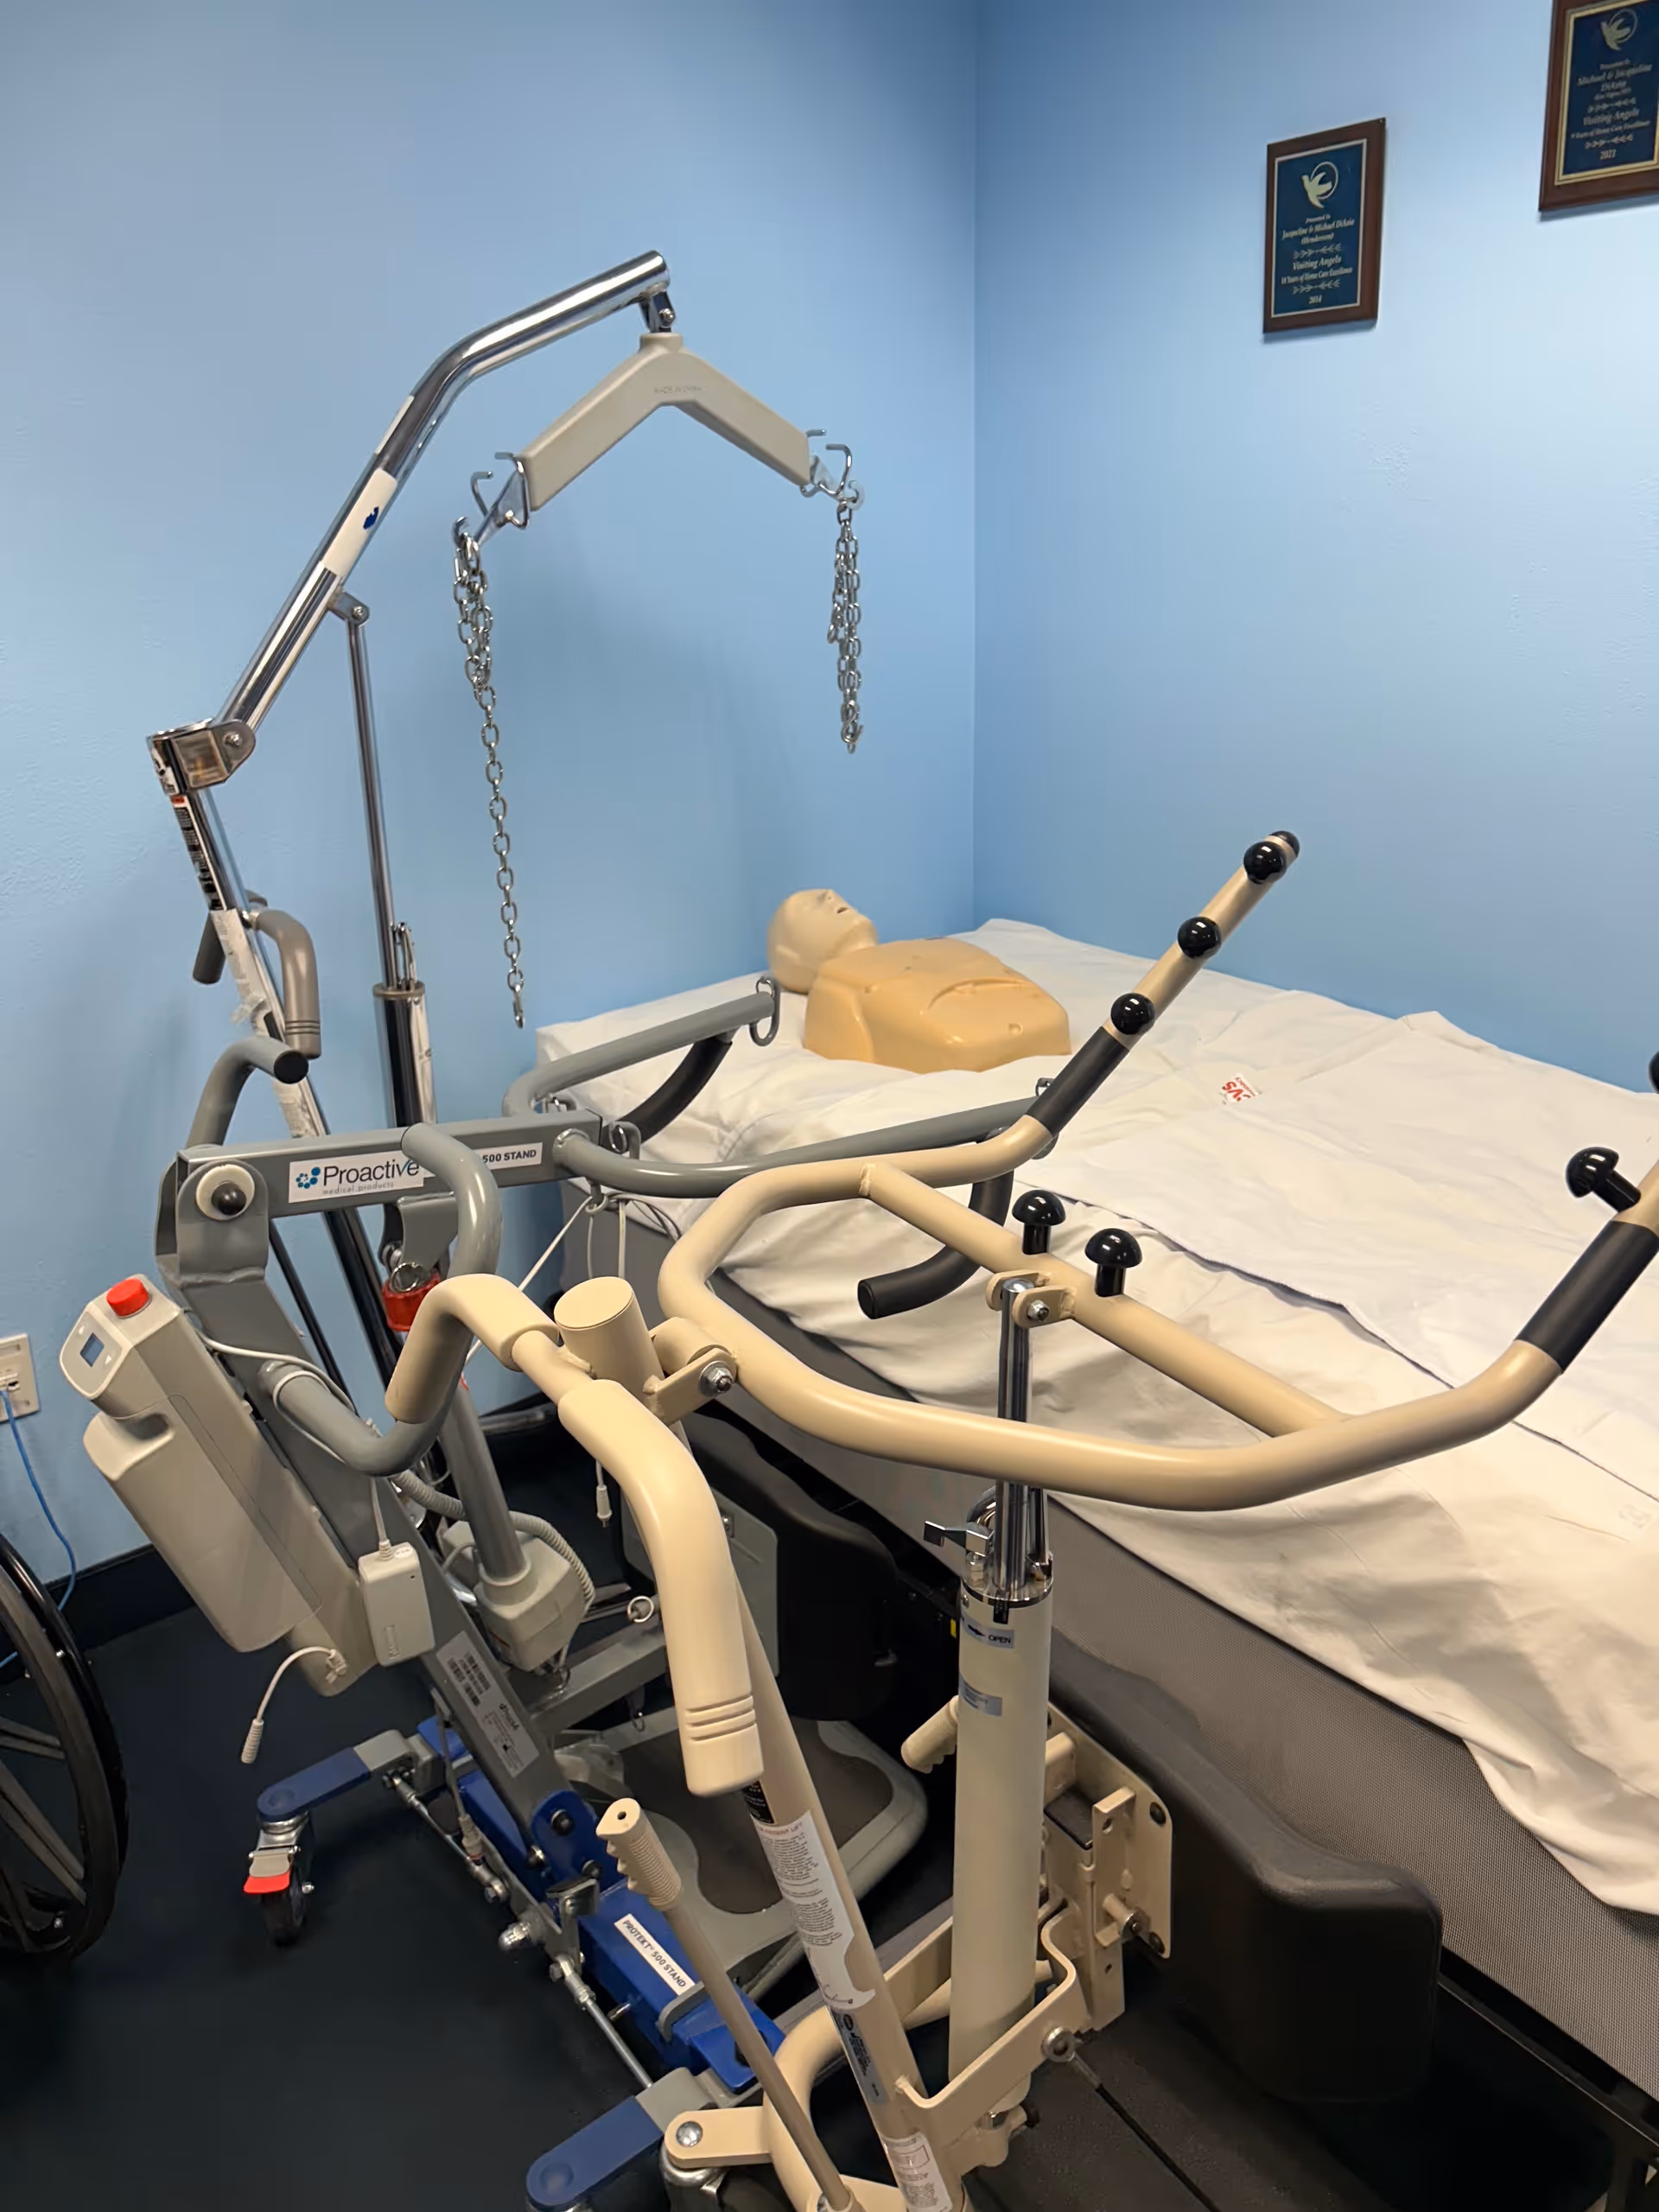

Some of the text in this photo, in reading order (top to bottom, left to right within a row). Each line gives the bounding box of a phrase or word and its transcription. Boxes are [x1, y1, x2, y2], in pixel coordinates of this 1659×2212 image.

[1293, 255, 1342, 270] Visiting Angels
[482, 1149, 537, 1163] 500 STAND
[323, 1159, 420, 1186] Proactive
[358, 1181, 394, 1192] products
[988, 1634, 1011, 1644] OPEN
[652, 1951, 666, 1966] 500
[663, 1963, 687, 1987] STAND
